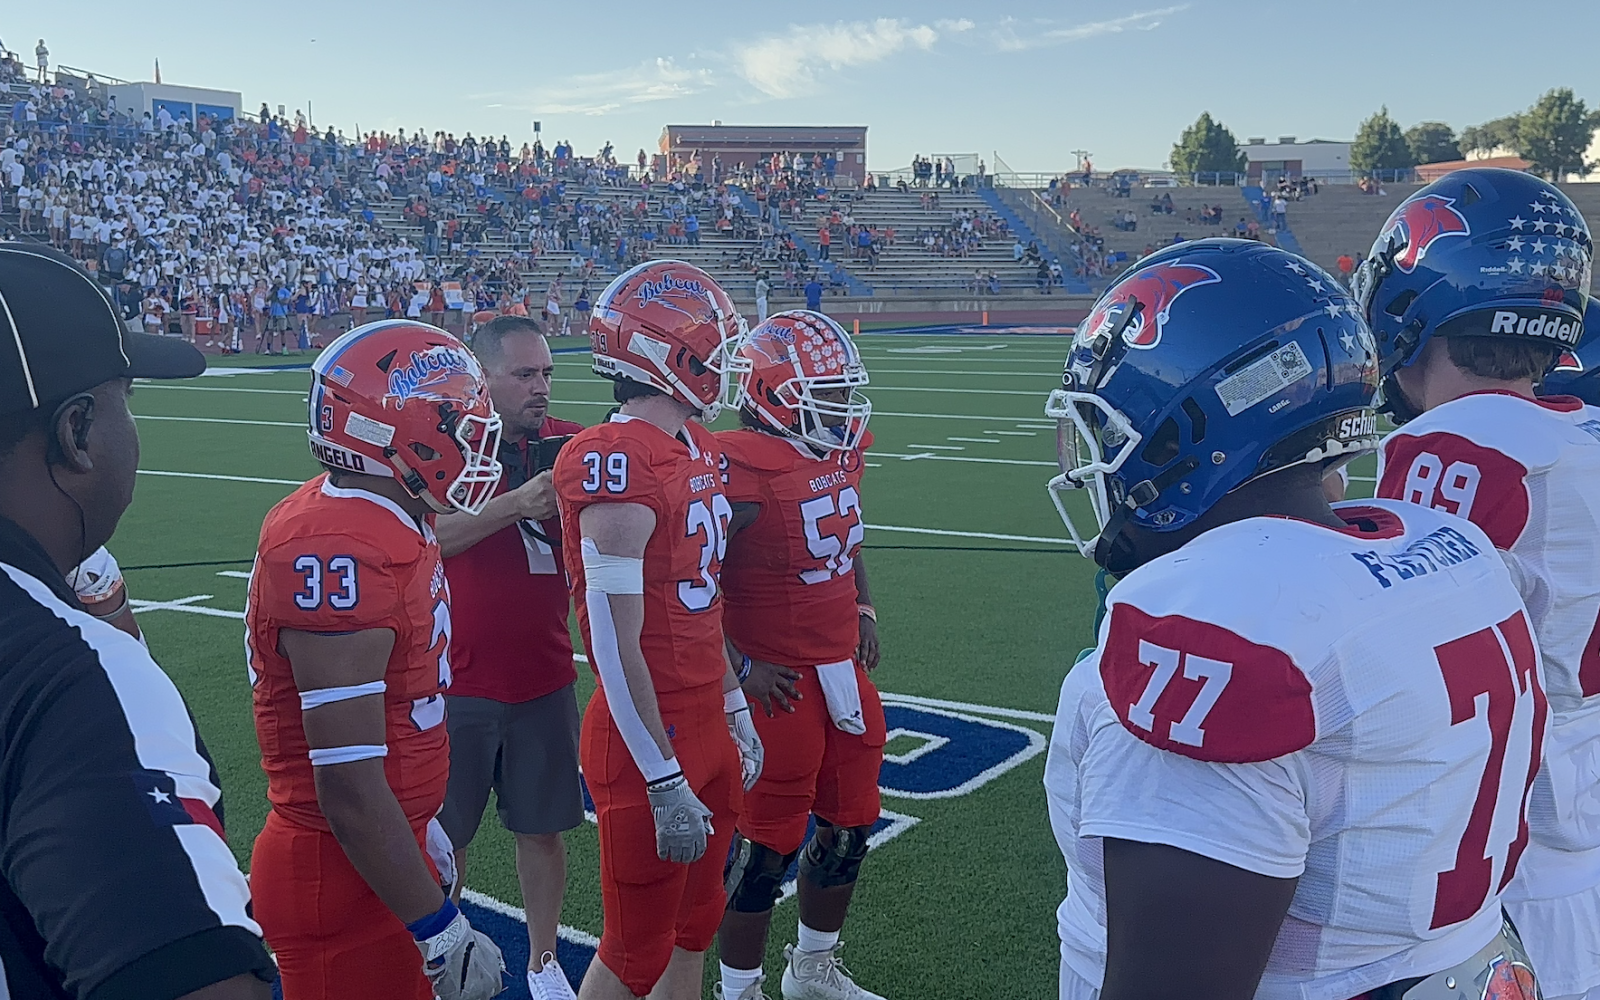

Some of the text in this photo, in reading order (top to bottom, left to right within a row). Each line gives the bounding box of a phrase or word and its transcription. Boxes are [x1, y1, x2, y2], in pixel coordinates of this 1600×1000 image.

[638, 273, 709, 308] Bobcat
[1491, 311, 1581, 344] Riddell
[310, 441, 365, 472] ANGELO
[581, 450, 629, 494] 39
[809, 471, 847, 491] BOBCATS
[1403, 452, 1481, 520] 89
[798, 486, 865, 585] 52
[294, 555, 359, 611] 33
[1127, 639, 1233, 748] 77
[1429, 609, 1547, 931] 77
